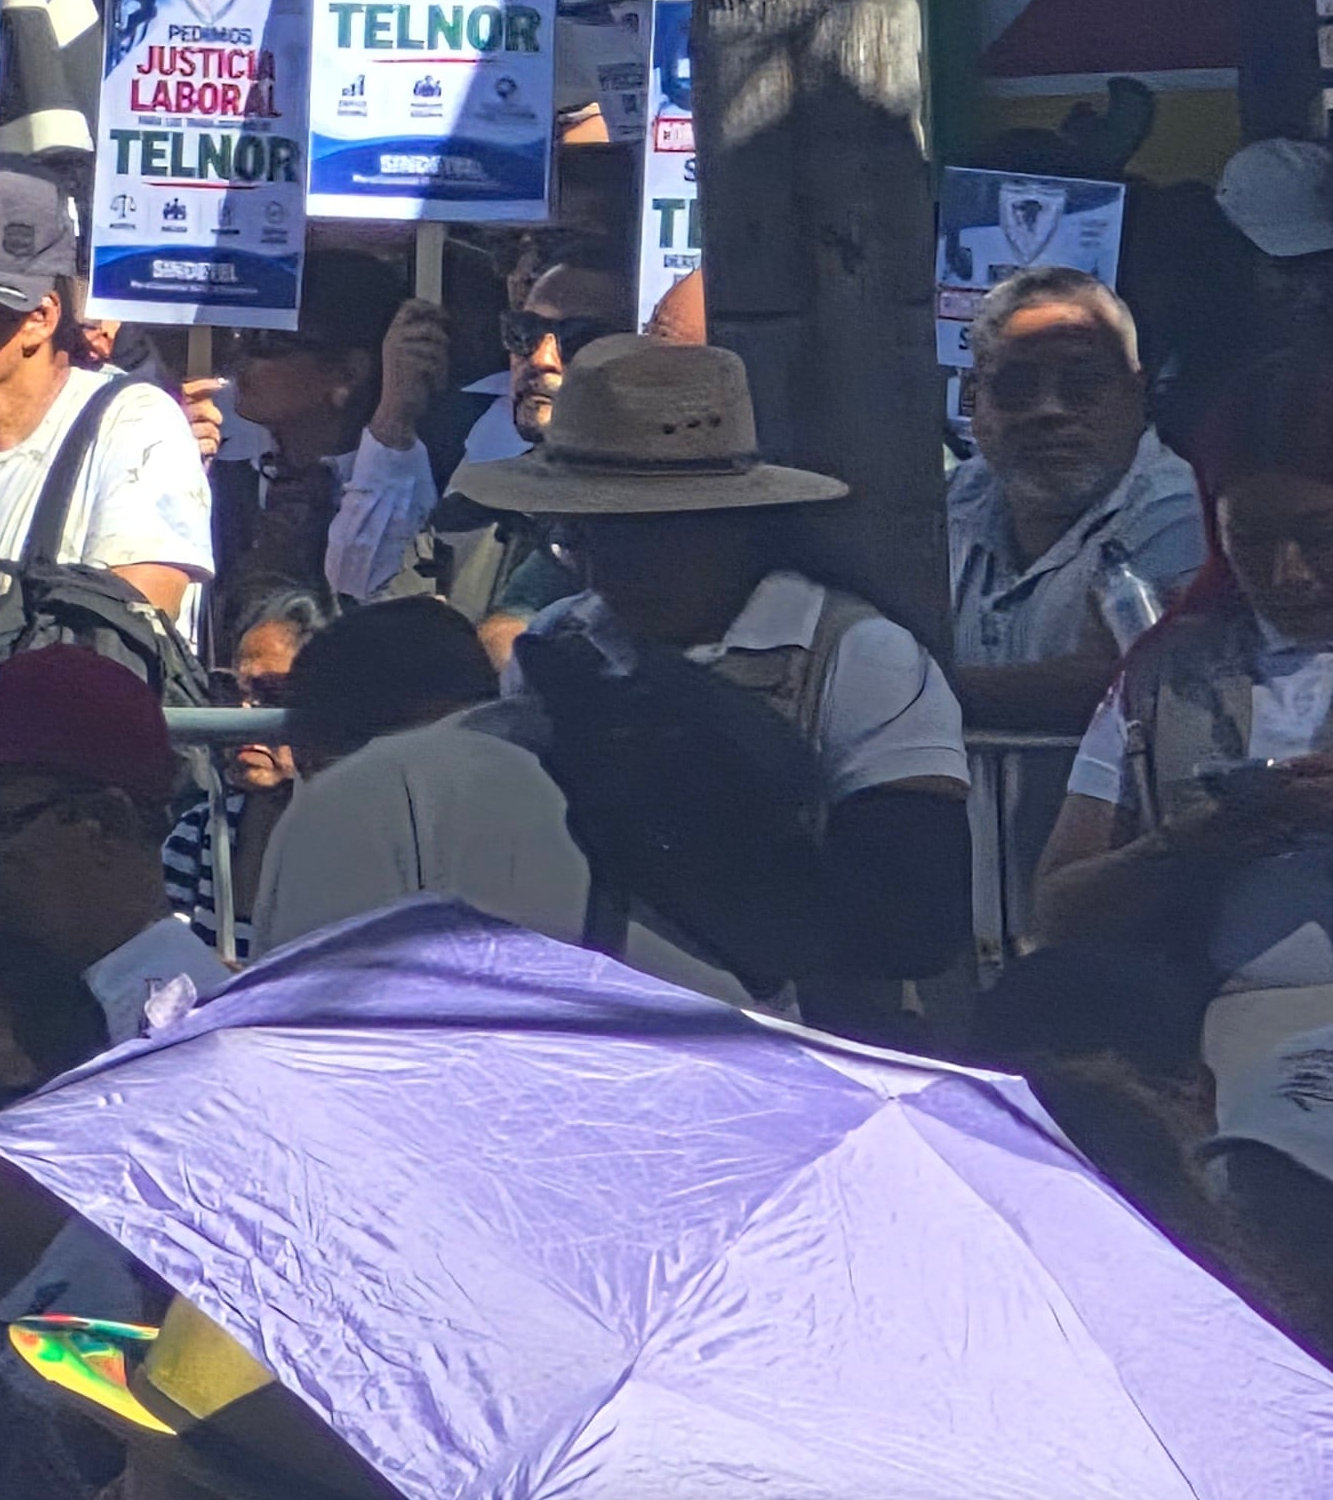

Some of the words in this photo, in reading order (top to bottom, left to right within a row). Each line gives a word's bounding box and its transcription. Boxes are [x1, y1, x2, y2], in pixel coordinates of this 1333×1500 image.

[328, 3, 541, 52] TELNOR
[136, 45, 276, 82] JUSTICIA
[130, 79, 282, 117] LABORAL
[110, 129, 300, 182] TELNOR
